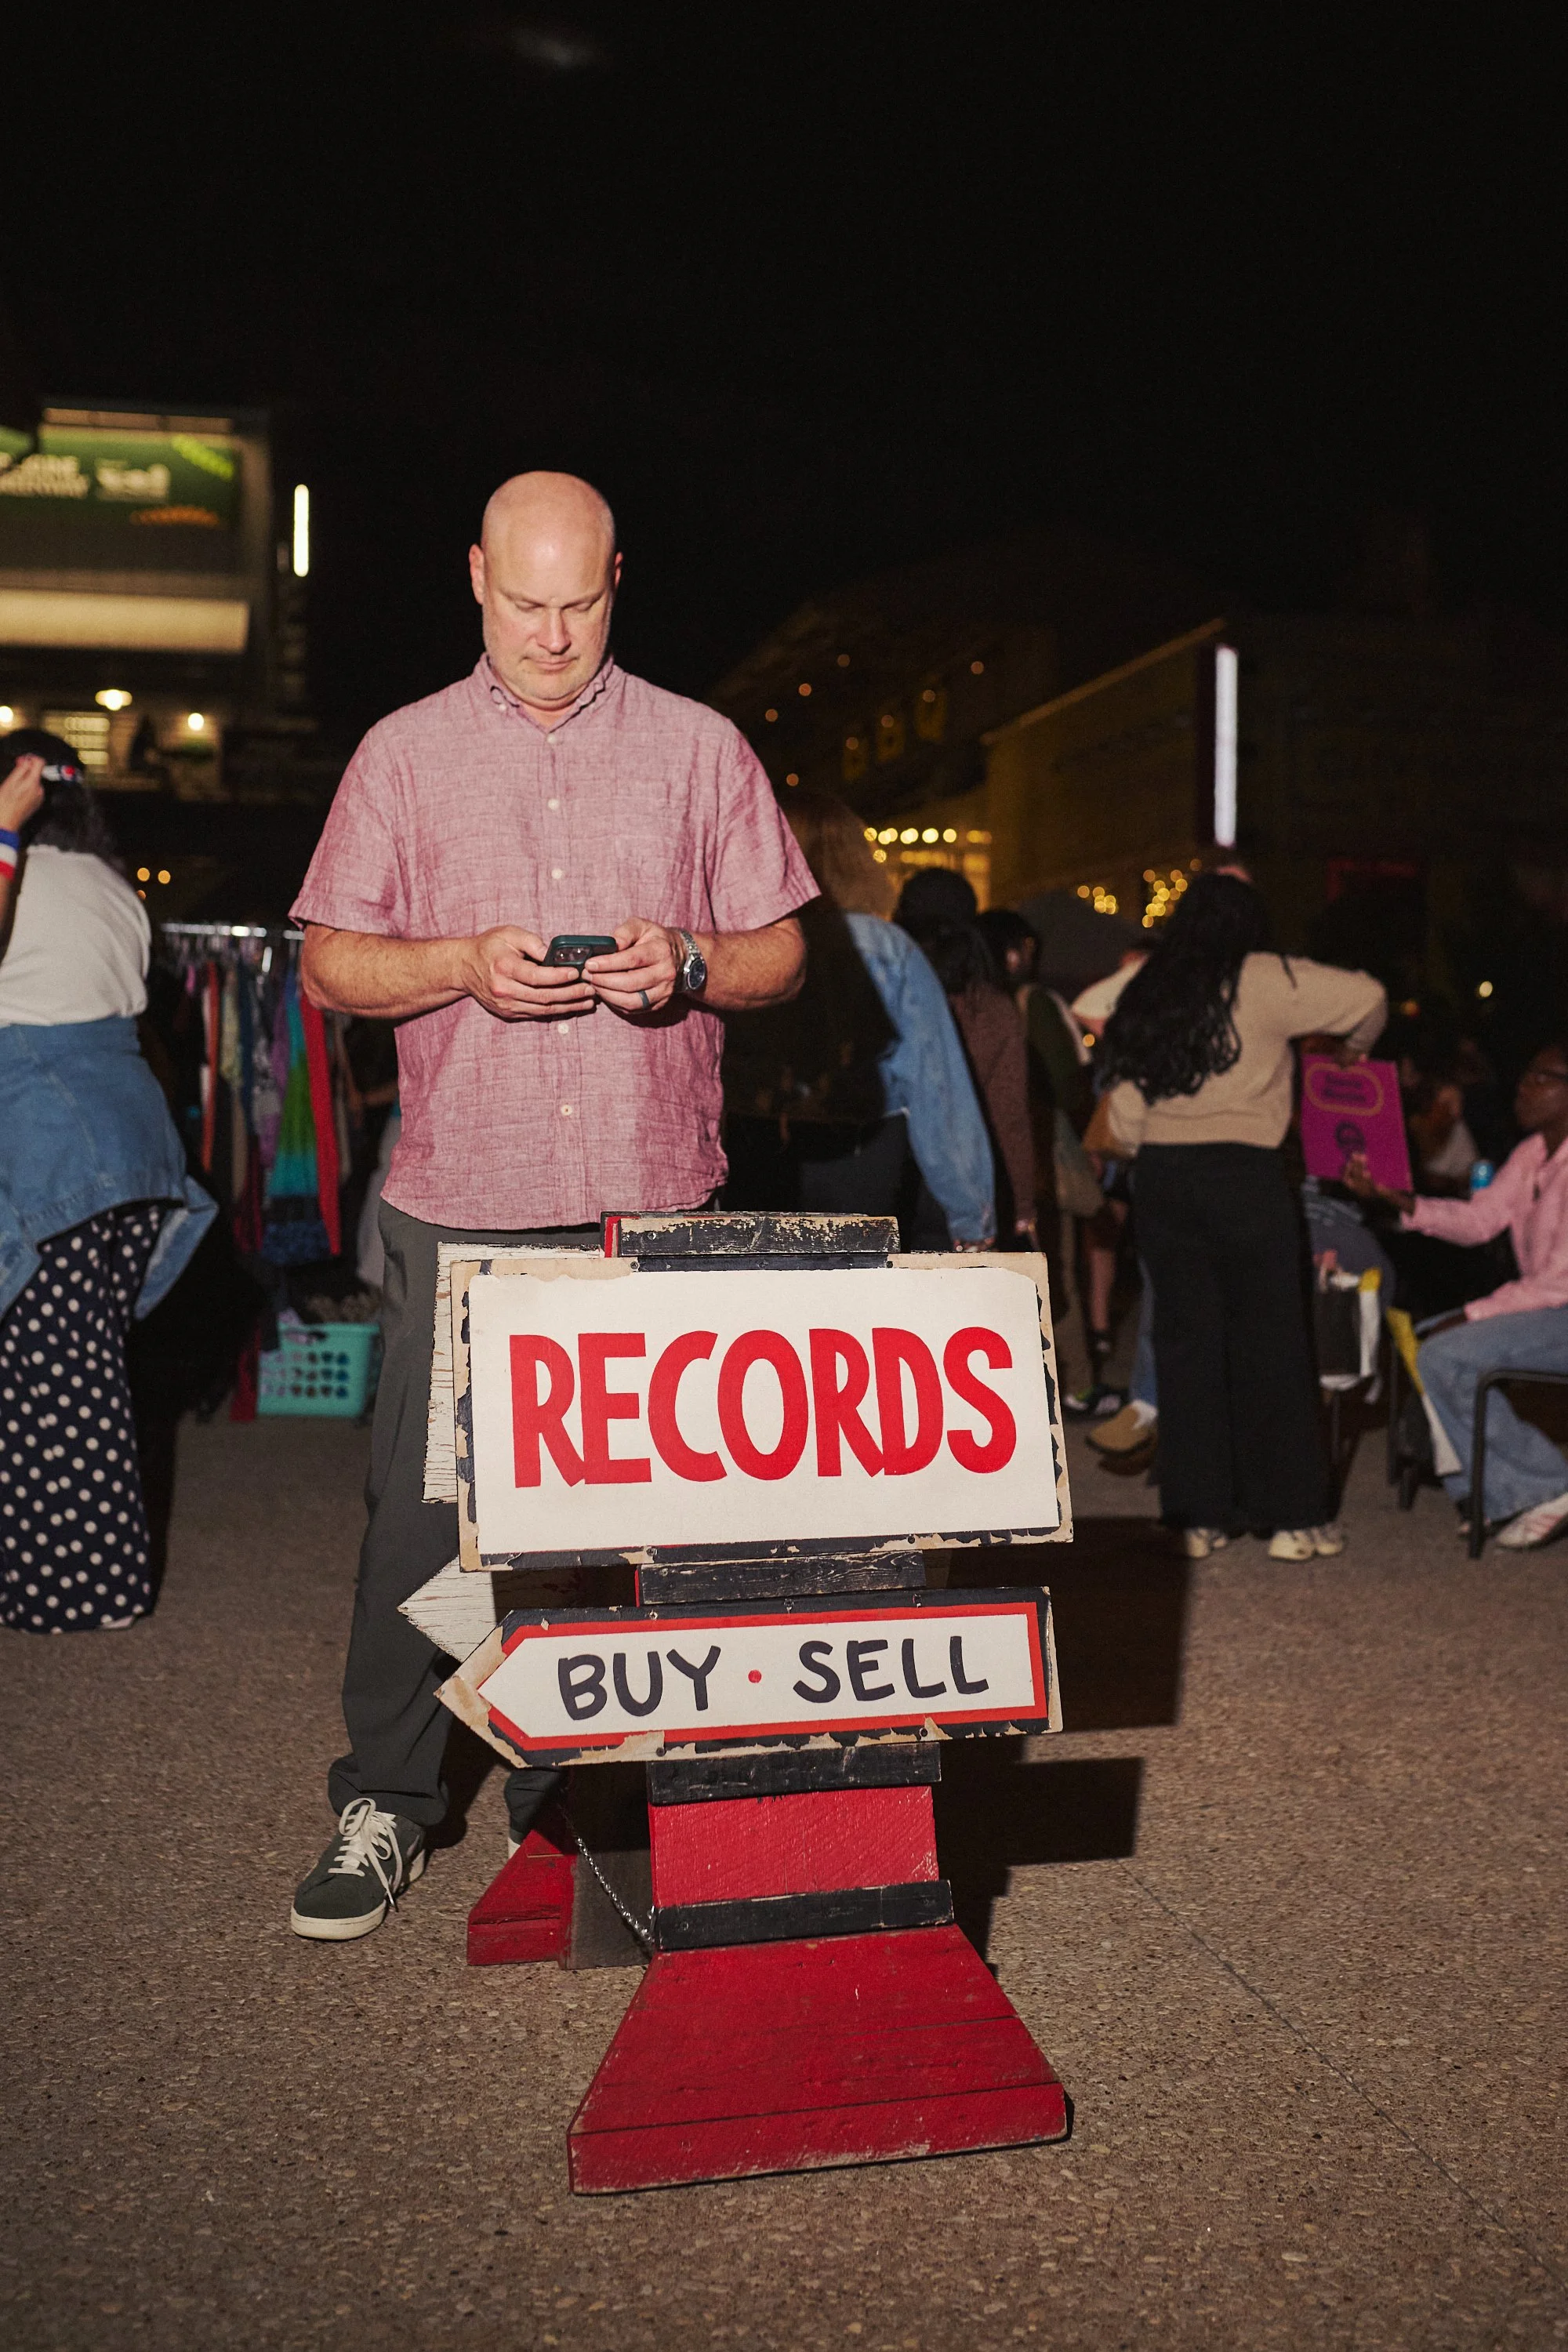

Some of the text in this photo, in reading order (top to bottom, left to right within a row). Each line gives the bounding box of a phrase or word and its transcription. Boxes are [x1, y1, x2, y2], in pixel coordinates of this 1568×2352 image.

[510, 1327, 1018, 1488] RECORDS
[557, 1635, 989, 1721] BUY SELL
